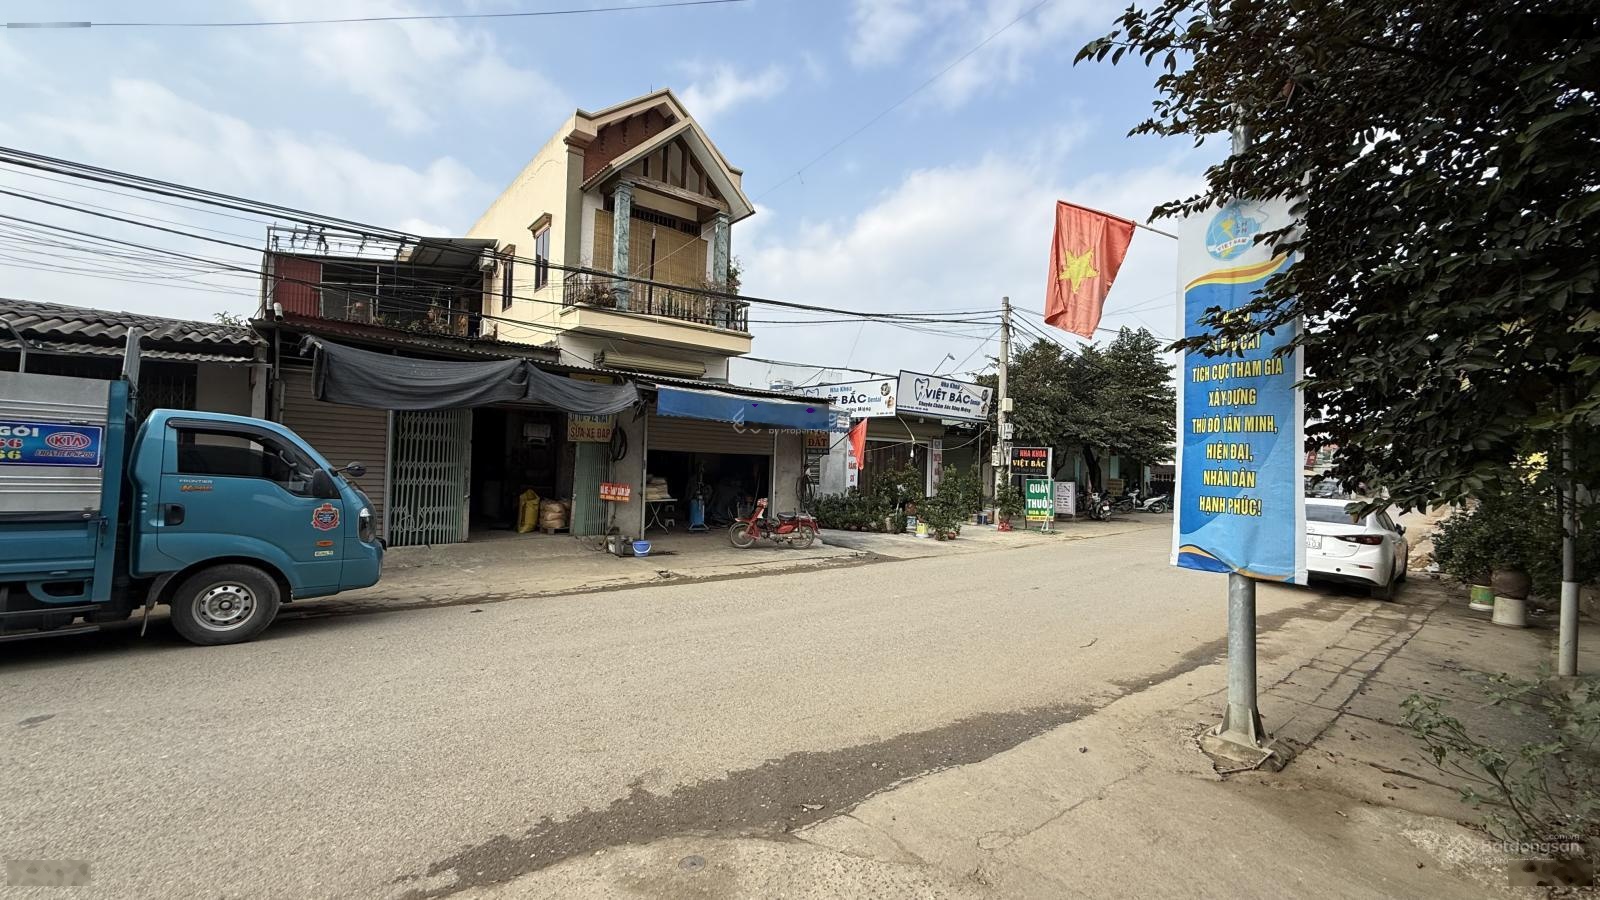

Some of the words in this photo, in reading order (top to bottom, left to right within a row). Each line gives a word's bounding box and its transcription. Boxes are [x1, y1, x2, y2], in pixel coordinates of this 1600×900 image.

[1192, 364, 1210, 383] TÍCH
[1211, 362, 1230, 383] CỰC
[1231, 360, 1262, 378] THAM
[1264, 357, 1283, 376] GIA
[841, 390, 867, 405] BẮC
[925, 387, 948, 403] VIỆT
[948, 387, 971, 404] BẮC
[1226, 387, 1257, 409] DỰNG
[1192, 413, 1207, 434] THỦ
[1207, 414, 1221, 433] ĐÔ
[1222, 413, 1241, 433] VĂN
[1244, 415, 1278, 435] MINH,
[1019, 449, 1031, 458] NHA
[1031, 449, 1047, 458] KHOA
[1206, 440, 1229, 463] HIỆN
[1230, 443, 1254, 463] ĐẠI,
[1012, 458, 1029, 468] VIỆT
[1203, 467, 1230, 487] NHÂN
[1231, 467, 1256, 488] DÂN
[1027, 495, 1053, 509] THUỐC
[1199, 495, 1226, 515] HẠNH
[1227, 494, 1262, 517] PHÚC!
